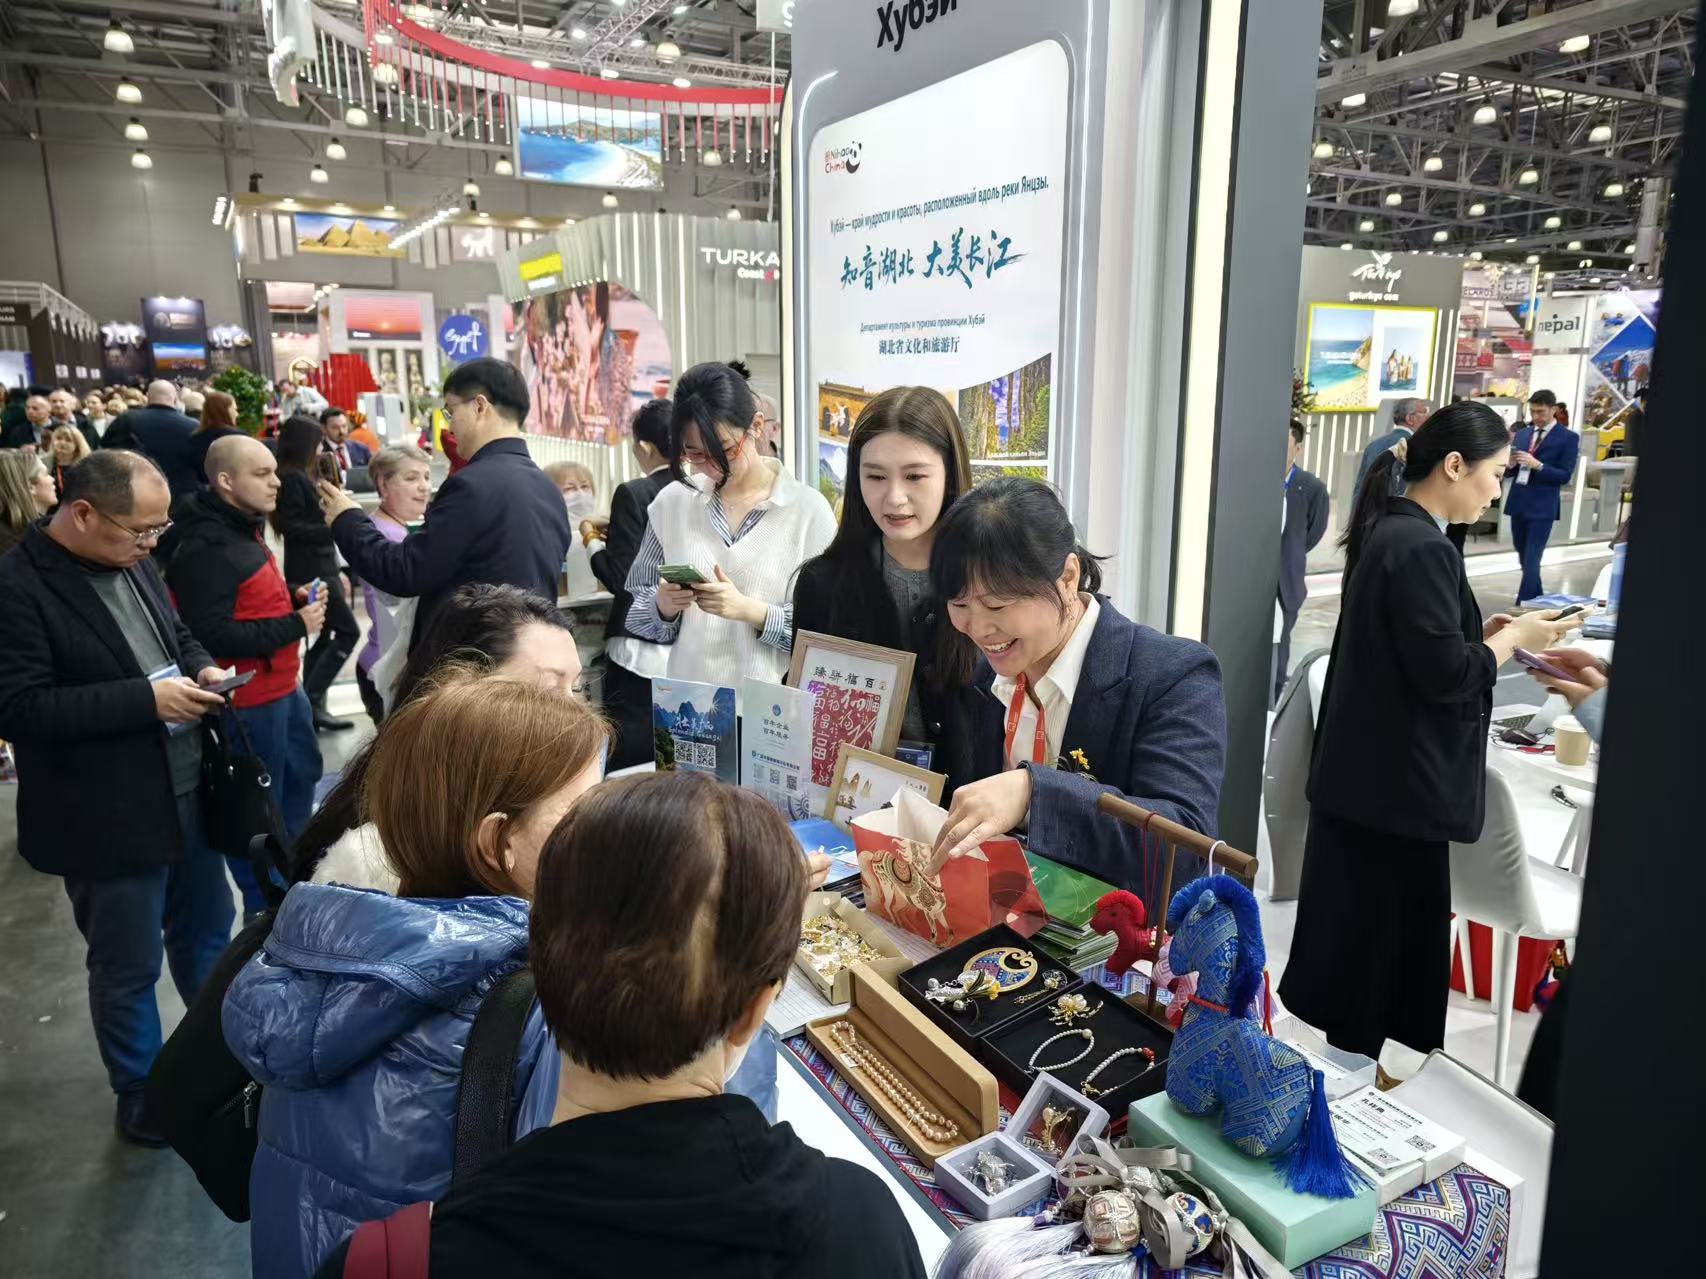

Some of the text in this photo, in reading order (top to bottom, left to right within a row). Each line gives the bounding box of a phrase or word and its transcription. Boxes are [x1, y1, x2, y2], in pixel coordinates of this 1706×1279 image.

[830, 217, 845, 237] Хубэй
[851, 212, 864, 232] край
[864, 210, 891, 230] мудрости
[891, 209, 896, 220] и
[896, 203, 923, 223] красоты,
[923, 186, 977, 218] расположенный
[978, 185, 1000, 206] вдоль
[1001, 180, 1020, 204] реки
[1020, 175, 1049, 196] Янцзы.
[840, 227, 1030, 291] 知音湖北 大美长江
[916, 319, 937, 330] туризма
[937, 317, 967, 329] провинции
[968, 313, 985, 328] Хубэй
[1538, 314, 1580, 335] nepal
[879, 335, 960, 355] 湖北省文化和旅游厅
